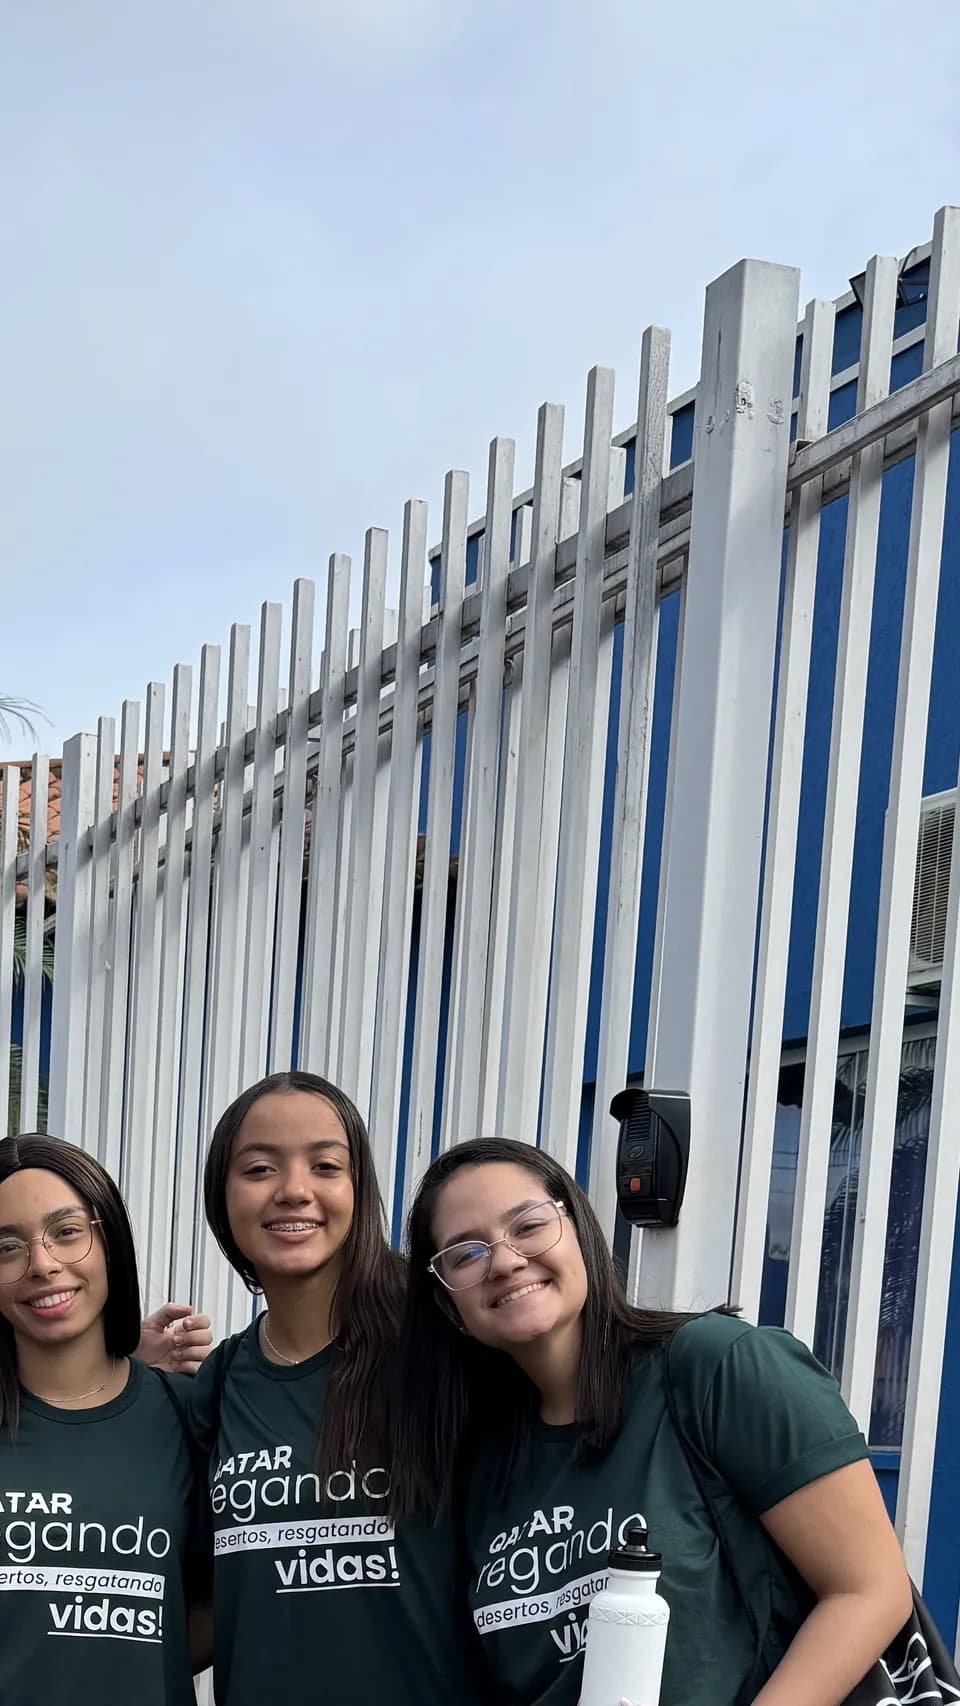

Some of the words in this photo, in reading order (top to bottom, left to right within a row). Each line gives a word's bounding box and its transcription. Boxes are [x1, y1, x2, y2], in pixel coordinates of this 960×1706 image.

[213, 1445, 293, 1482] ATAR
[209, 1459, 392, 1523] egando
[214, 1530, 273, 1550] esertos,
[277, 1518, 390, 1544] resgatando
[488, 1505, 575, 1554] QAAR
[55, 1572, 163, 1594] resgatando
[274, 1546, 401, 1586] vidas!
[48, 1595, 163, 1637] vidas!
[476, 1600, 553, 1629] desertos,
